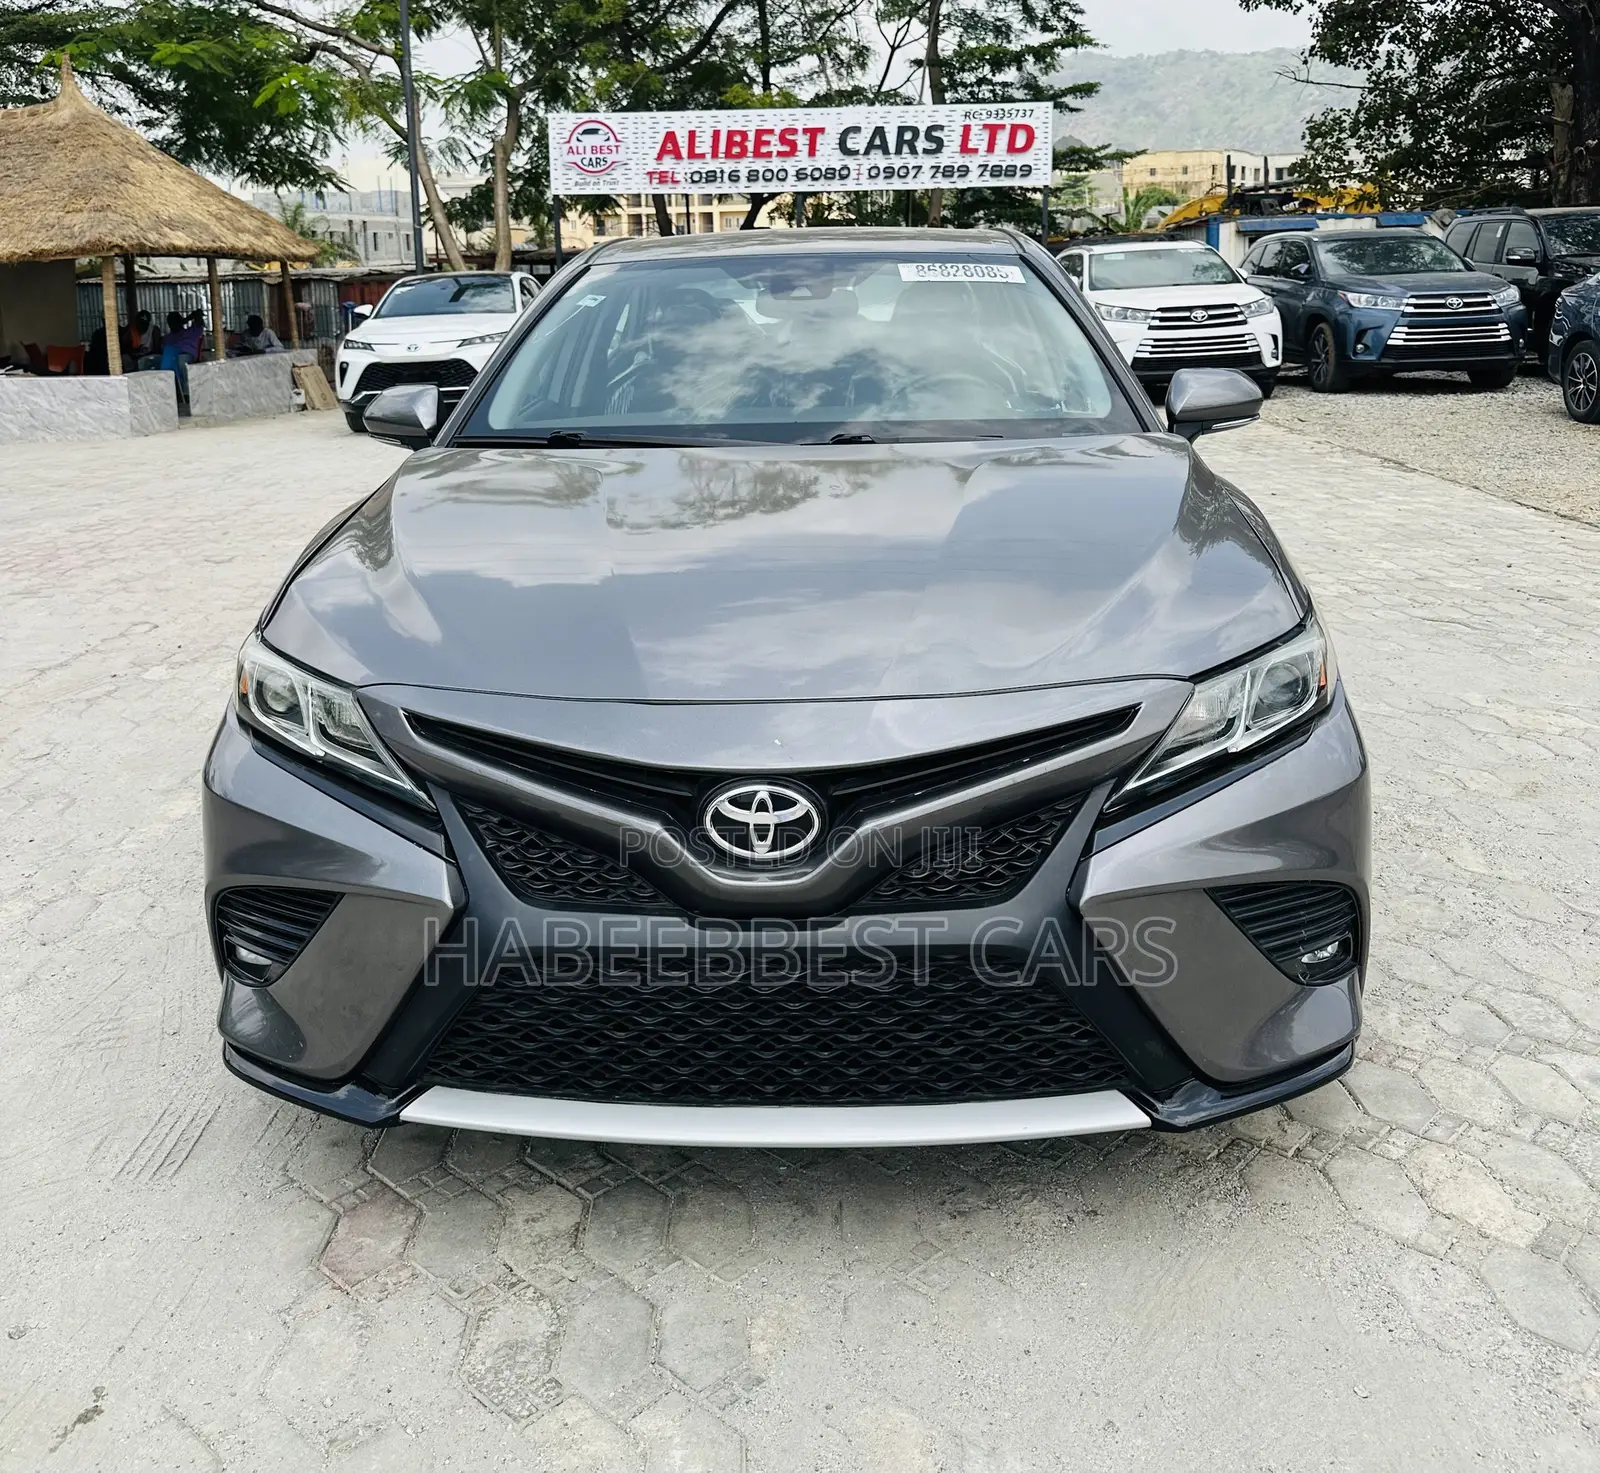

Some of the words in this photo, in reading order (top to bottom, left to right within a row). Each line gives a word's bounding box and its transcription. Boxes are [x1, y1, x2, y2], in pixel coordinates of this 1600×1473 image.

[656, 127, 825, 161] ALIBEST
[838, 124, 945, 156] CARS
[958, 123, 1035, 154] LTD
[567, 145, 586, 155] ALI
[590, 145, 620, 155] BEST
[581, 157, 608, 168] CARS
[690, 169, 740, 184] 0816
[747, 168, 788, 182] 800
[796, 166, 851, 181] 6080
[868, 165, 923, 179] 0907
[929, 164, 970, 178] 789
[977, 164, 1033, 178] 7889
